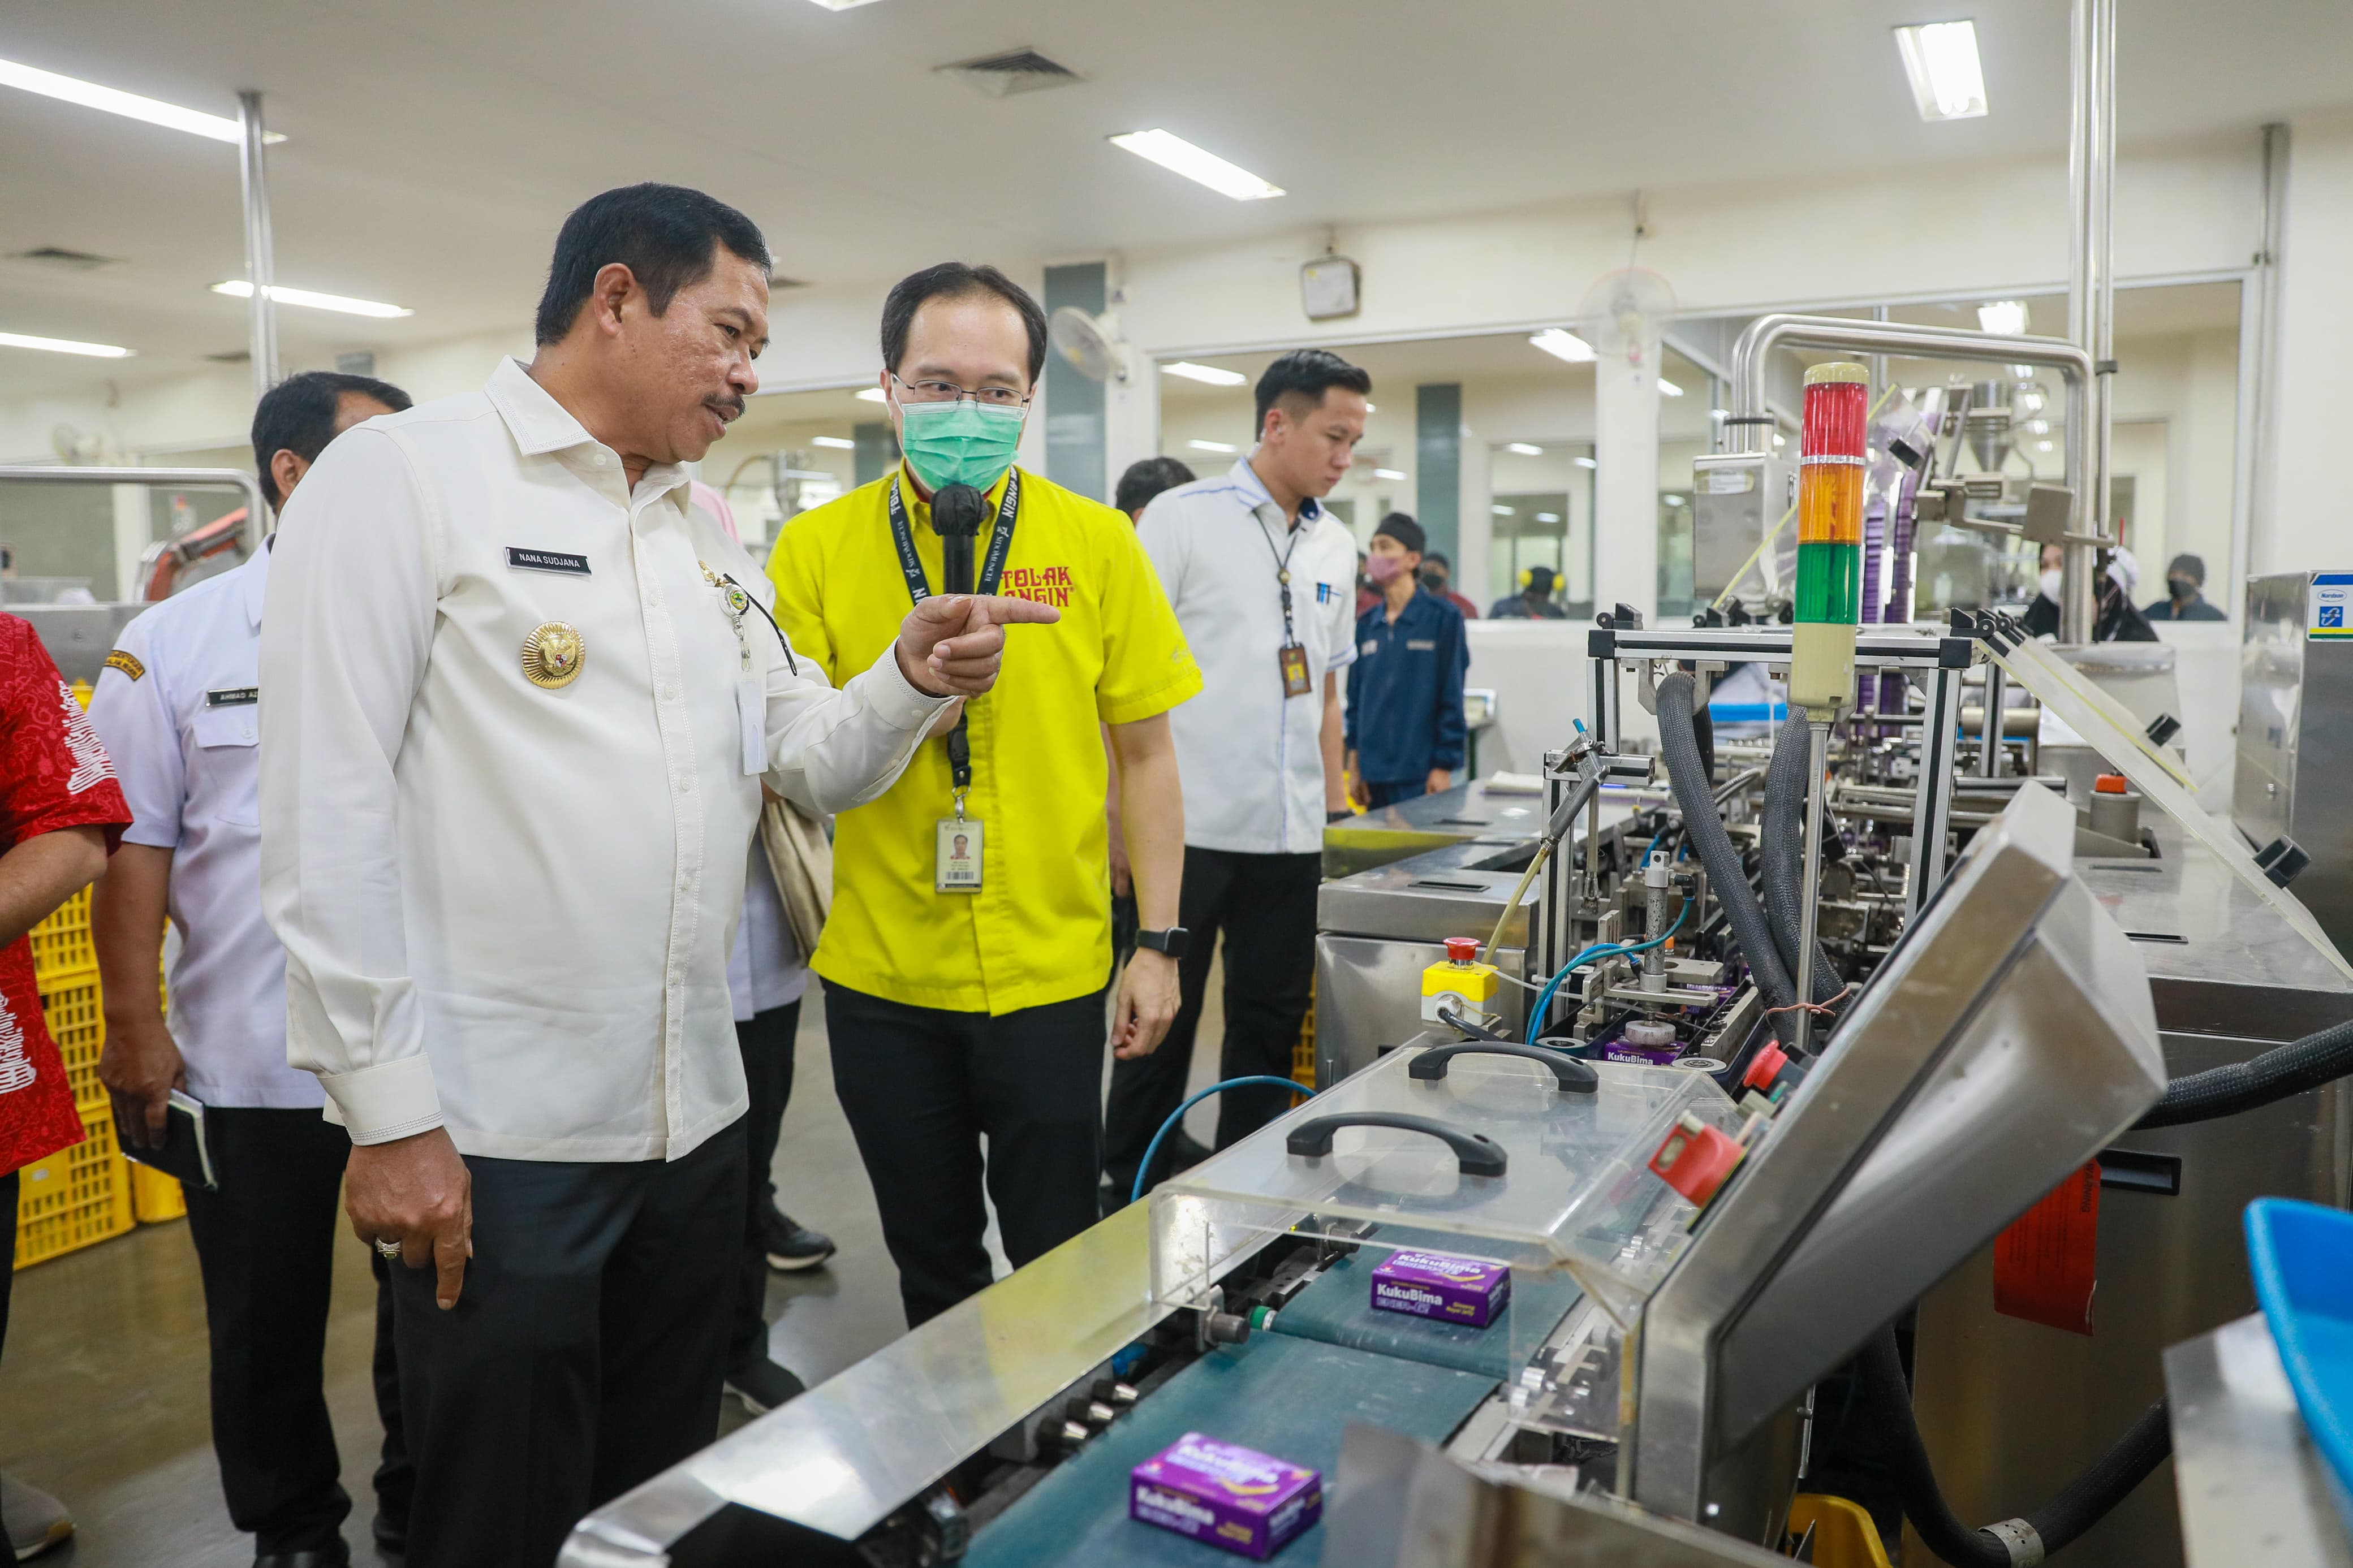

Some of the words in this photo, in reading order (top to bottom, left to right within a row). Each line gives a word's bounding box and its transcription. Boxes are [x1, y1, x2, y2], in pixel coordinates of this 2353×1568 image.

[1002, 480, 1019, 519] ANGIN
[519, 553, 542, 563] NANA
[542, 556, 580, 568] SUDJANA
[1001, 567, 1072, 589] TOLAK
[1608, 1052, 1653, 1065] KukuBima
[2081, 1163, 2095, 1213] WARNING
[1377, 1283, 1443, 1306] KukuBima
